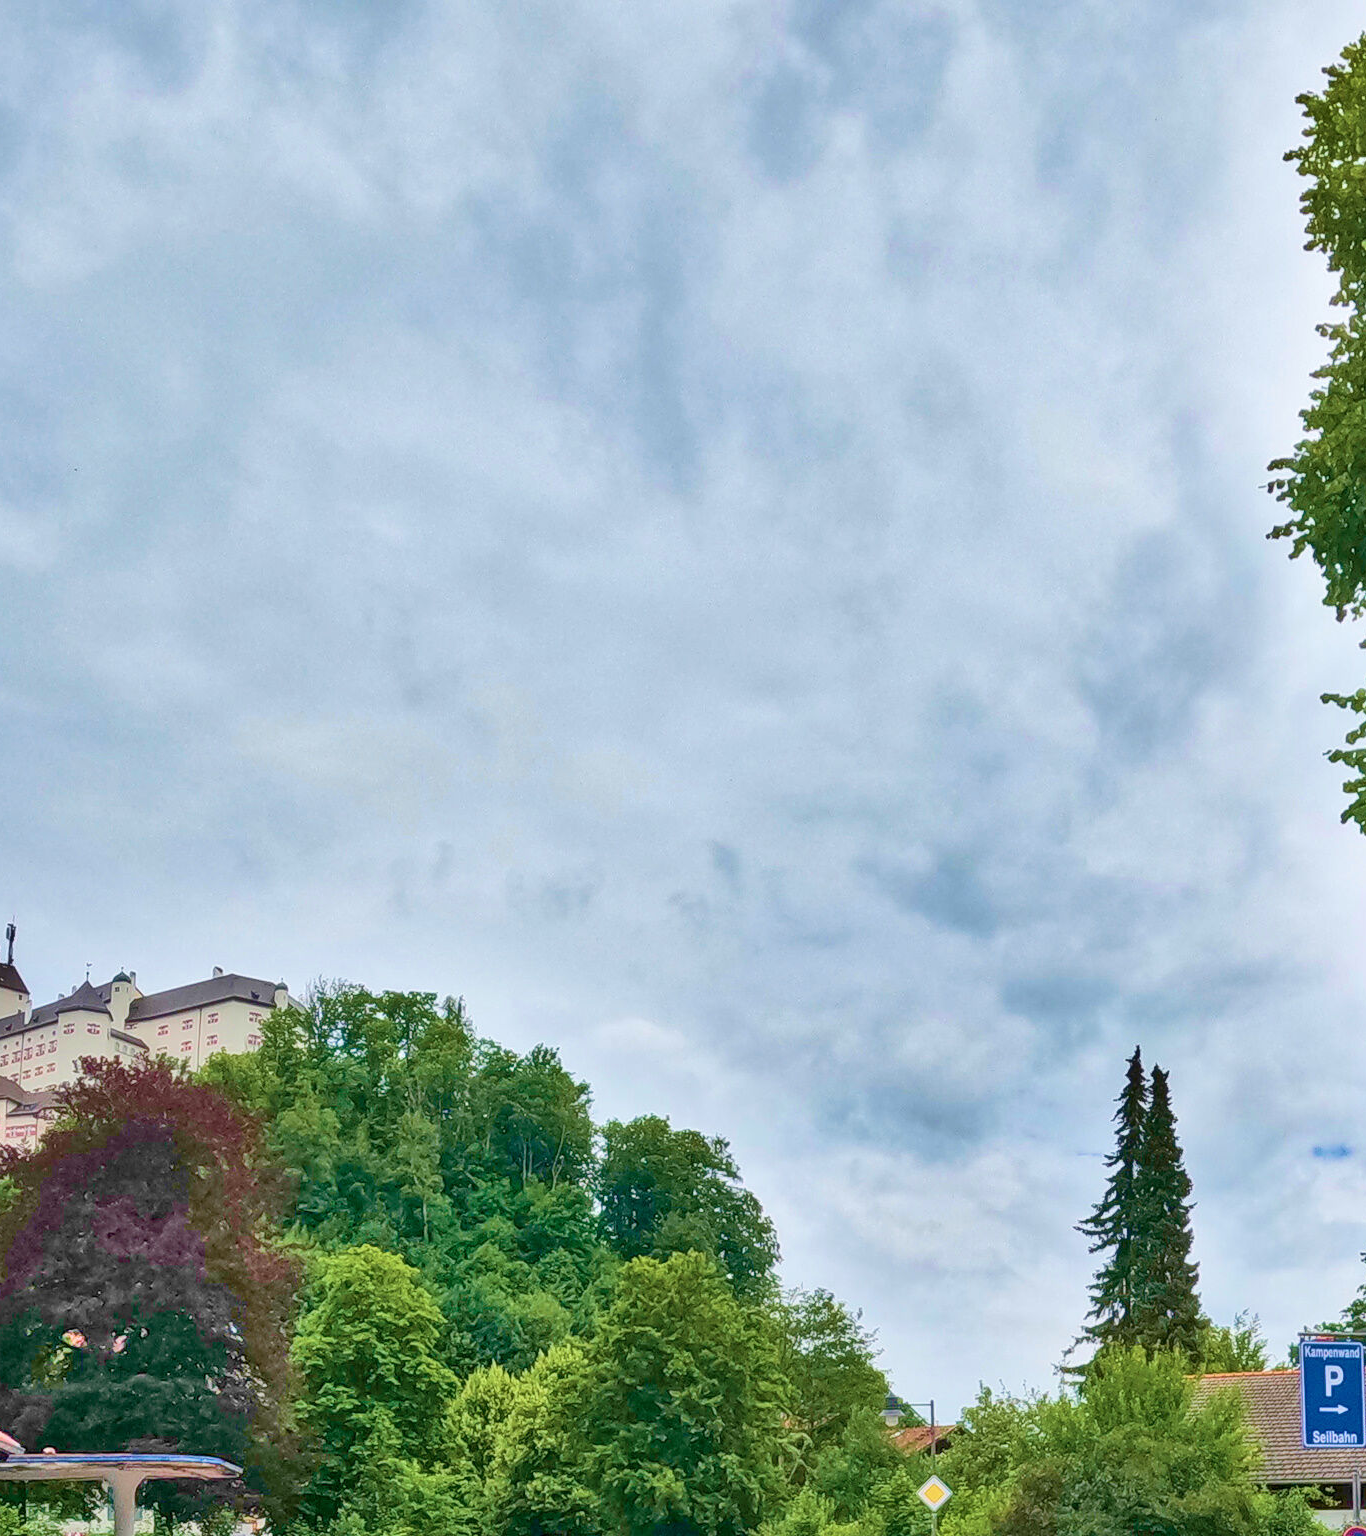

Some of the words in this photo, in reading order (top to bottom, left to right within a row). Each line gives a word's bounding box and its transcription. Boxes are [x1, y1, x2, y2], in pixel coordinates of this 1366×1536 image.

[1304, 1345, 1360, 1361] Kampenwand
[1324, 1364, 1344, 1397] P
[1312, 1430, 1358, 1444] Seilbahn
